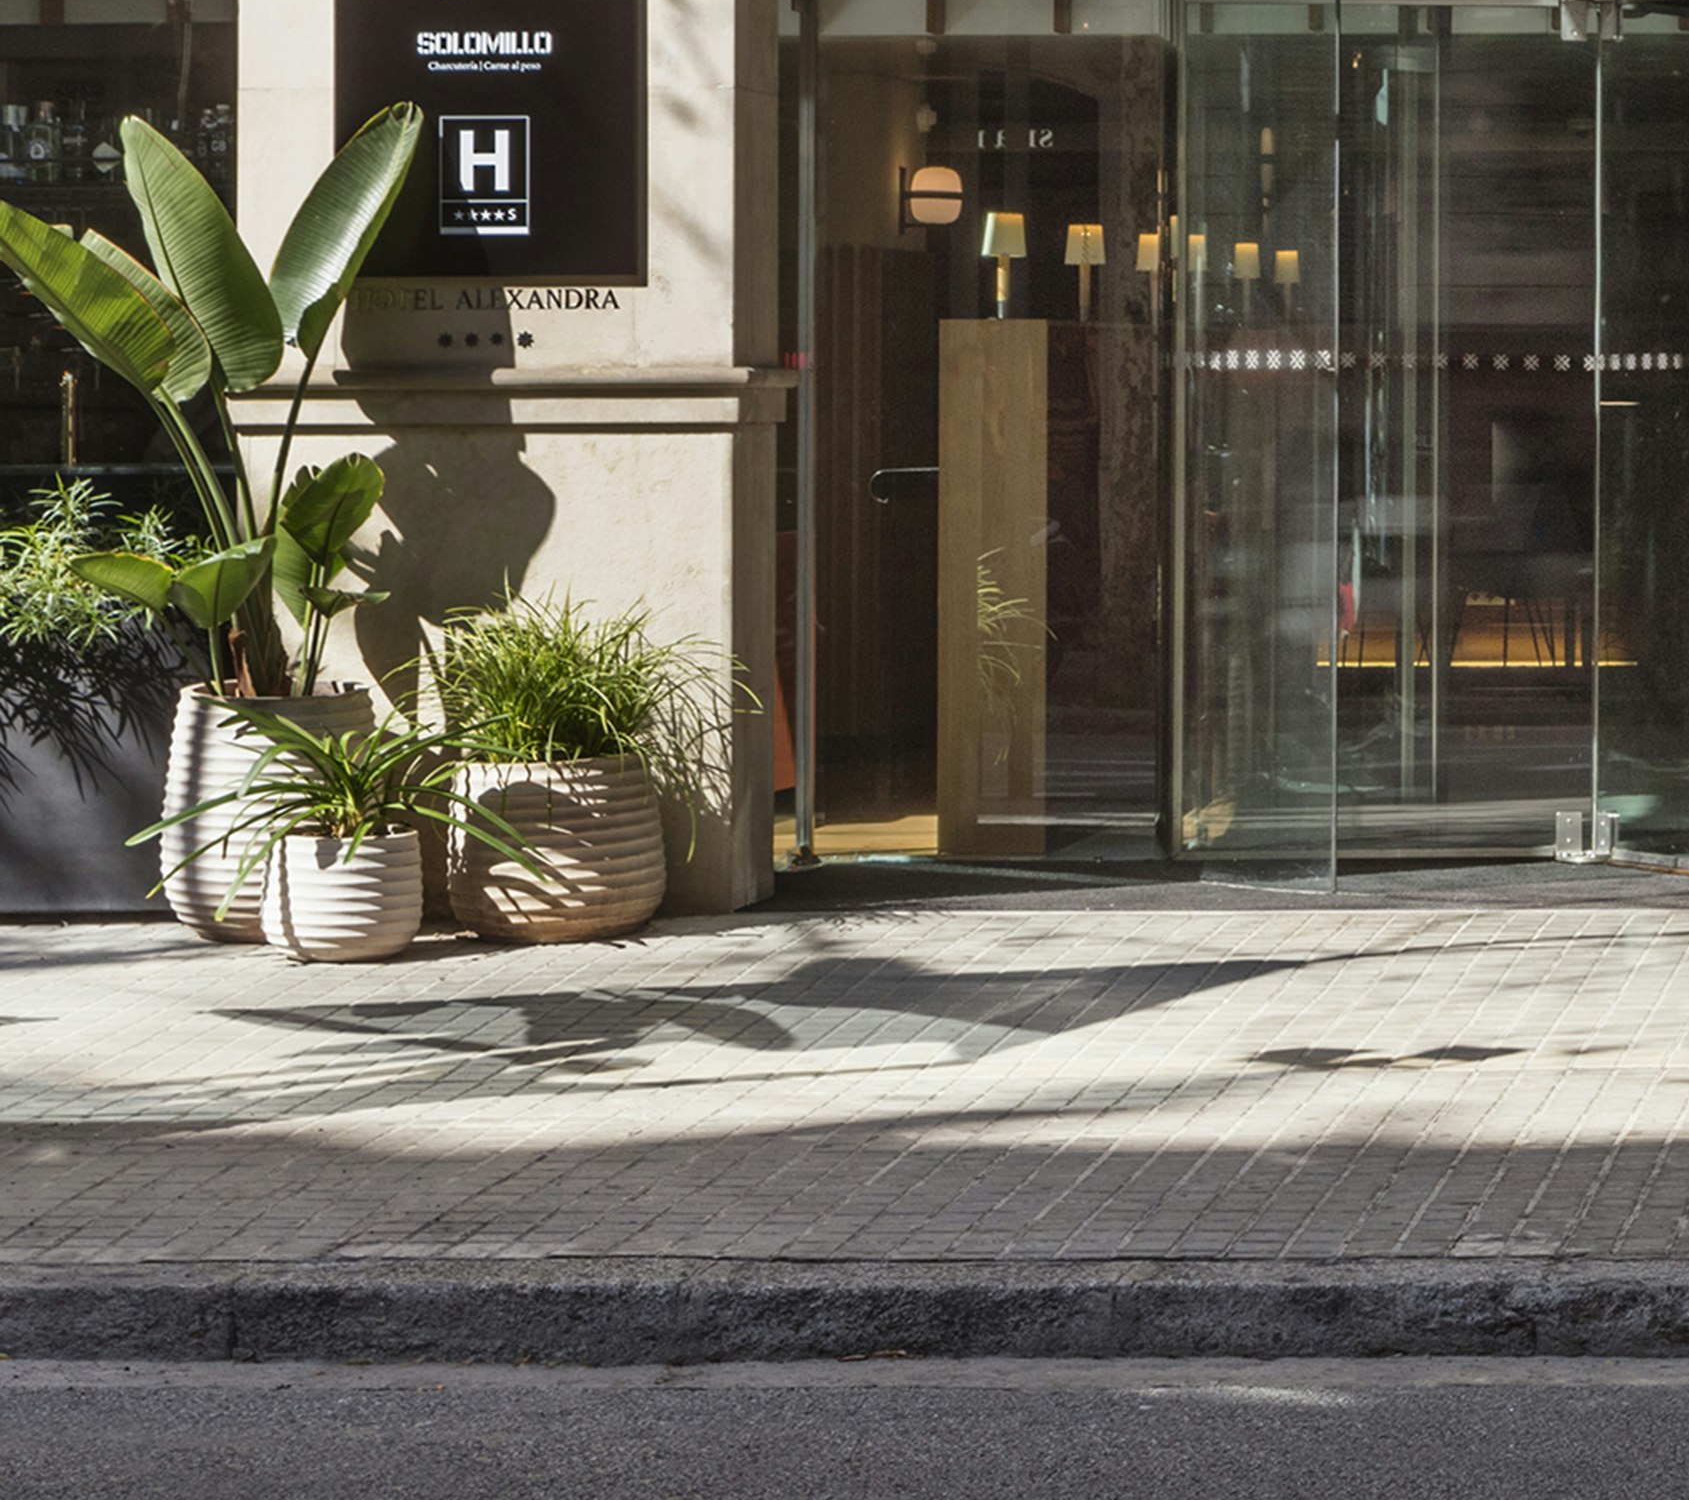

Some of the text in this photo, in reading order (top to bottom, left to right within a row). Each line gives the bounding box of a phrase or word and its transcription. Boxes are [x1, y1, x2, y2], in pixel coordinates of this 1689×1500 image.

[416, 31, 553, 55] SOLOMILLO
[483, 60, 510, 71] Carne
[459, 129, 510, 192] H
[353, 287, 621, 310] HOTEL ALEXANDRA
